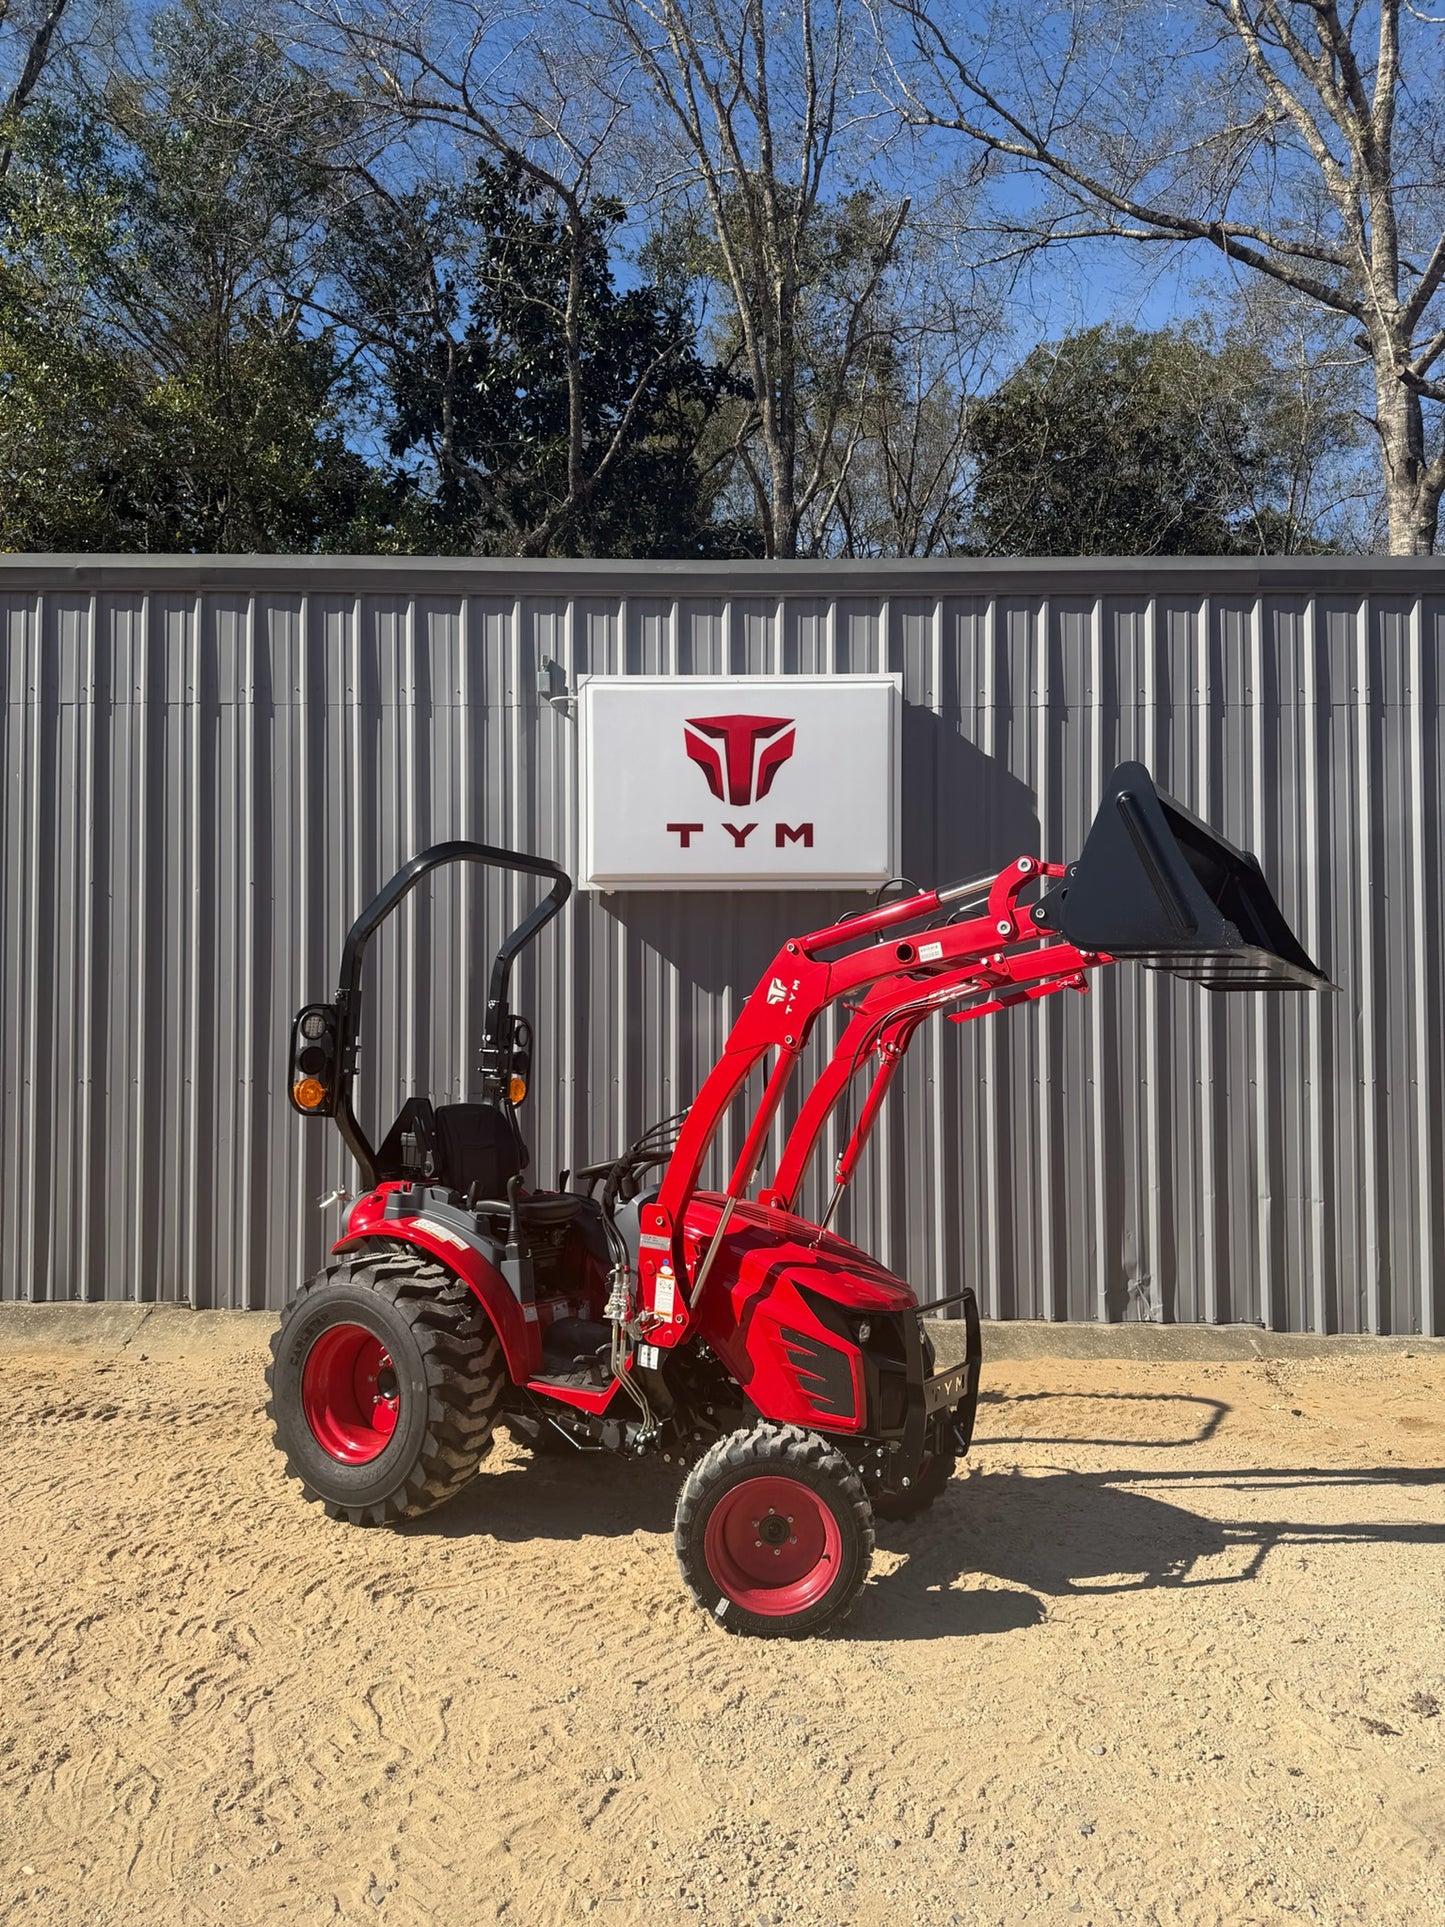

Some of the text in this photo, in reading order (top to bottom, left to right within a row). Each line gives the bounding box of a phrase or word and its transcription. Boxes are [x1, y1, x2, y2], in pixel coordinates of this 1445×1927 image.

[667, 823, 814, 848] TYM
[785, 979, 800, 1015] TYM
[931, 1374, 965, 1403] TYM
